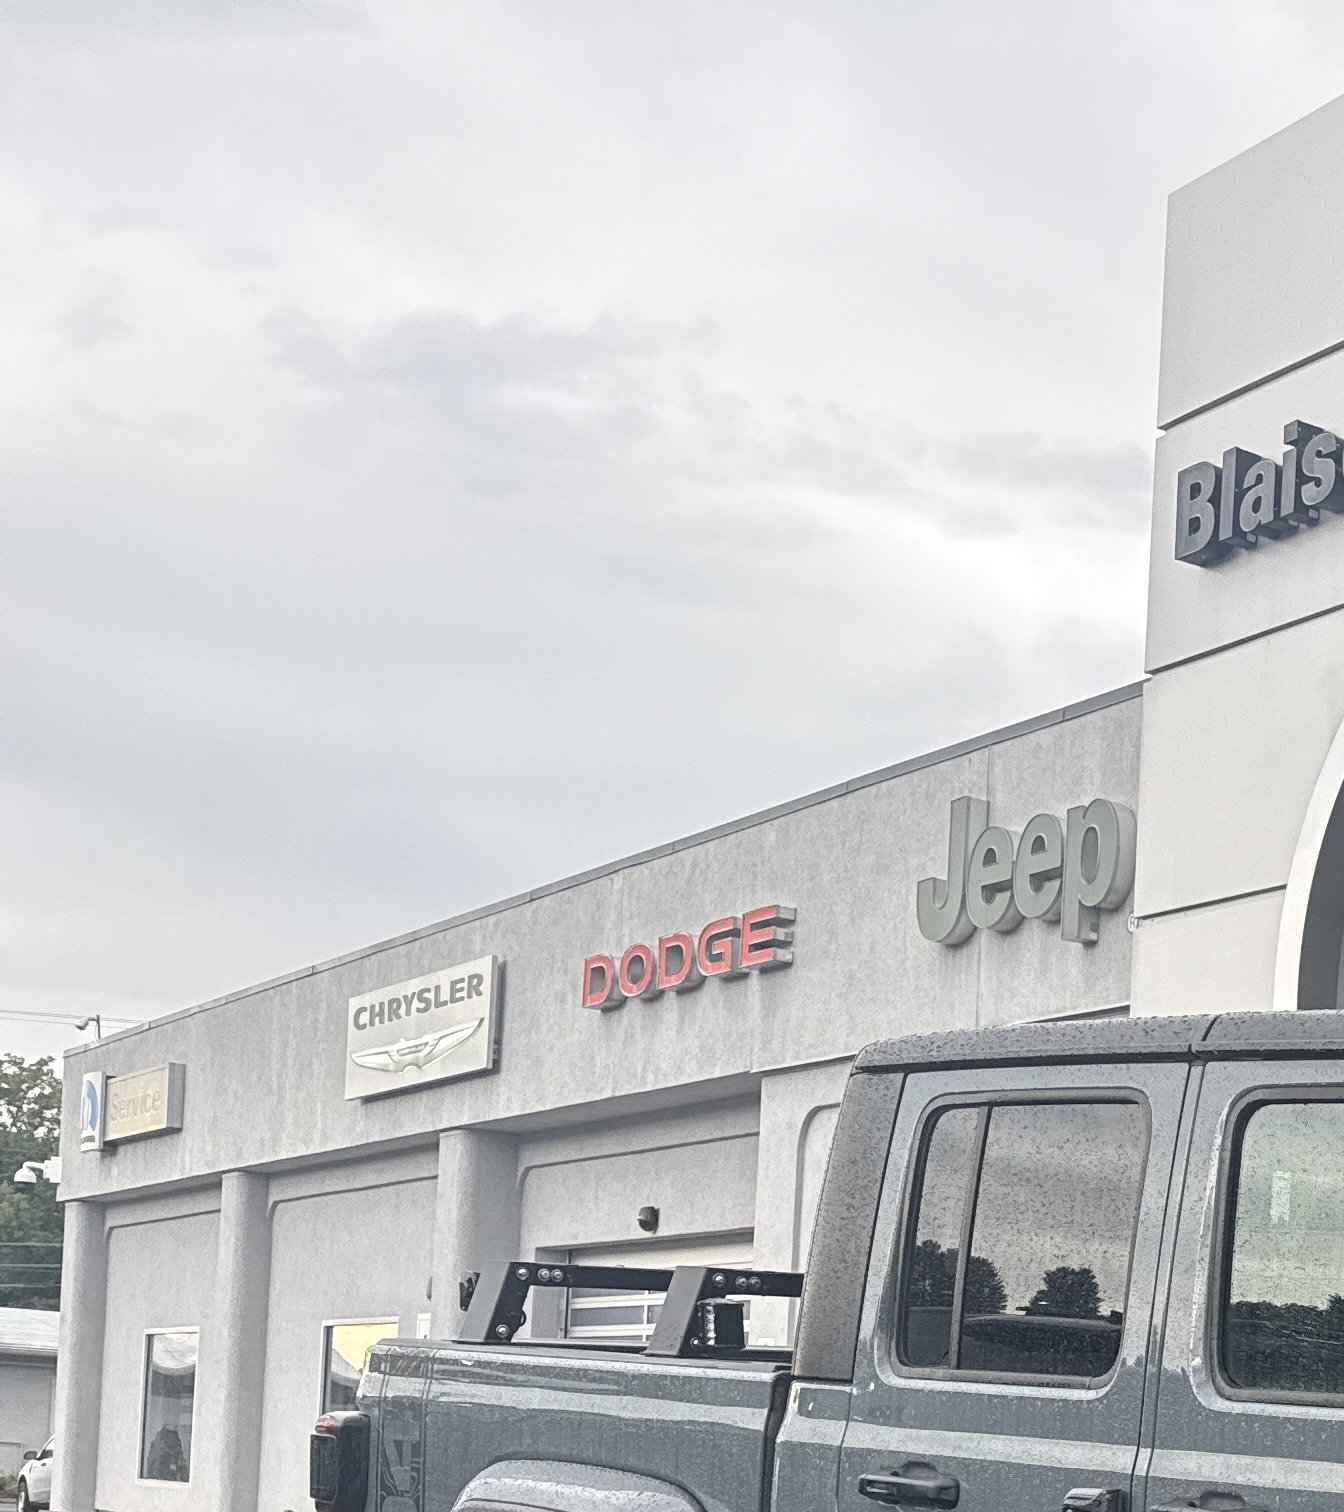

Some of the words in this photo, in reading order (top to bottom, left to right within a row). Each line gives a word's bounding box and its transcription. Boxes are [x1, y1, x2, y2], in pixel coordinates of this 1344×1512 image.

[916, 796, 1130, 944] Jeep
[582, 904, 792, 1009] DODGE
[353, 973, 484, 1030] CHRYSLER
[111, 1090, 160, 1121] Service
